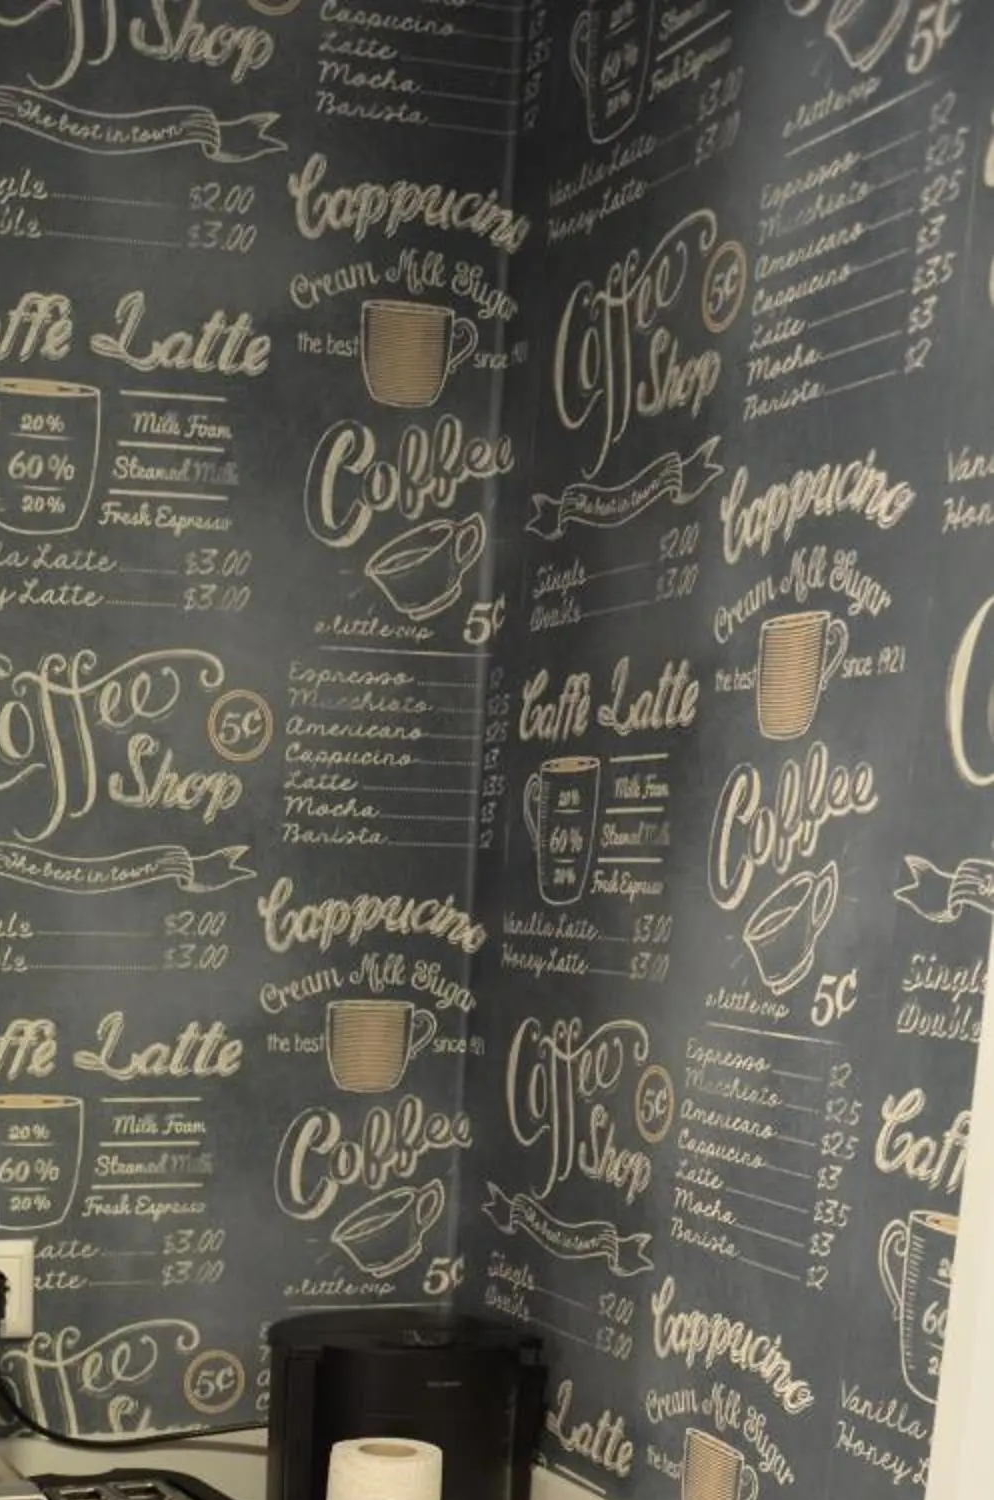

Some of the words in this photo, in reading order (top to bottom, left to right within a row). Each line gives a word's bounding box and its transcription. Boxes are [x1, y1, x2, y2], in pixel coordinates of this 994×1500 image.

[318, 60, 421, 93] Mocha
[316, 90, 428, 125] Barista
[289, 260, 382, 309] Cream
[89, 289, 273, 376] Latte
[297, 333, 323, 356] the
[326, 334, 360, 358] best
[554, 207, 717, 480] Coffee
[635, 325, 722, 419] Shop
[7, 451, 76, 482] 60%
[304, 413, 516, 549] Coffee
[20, 494, 67, 515] 20%
[98, 501, 152, 529] Fresh
[154, 504, 232, 538] Espresso
[31, 543, 118, 572] Latte
[19, 577, 105, 608] Latte
[712, 574, 778, 644] Cream
[288, 659, 416, 689] Espresso
[597, 656, 701, 737] Latte
[217, 708, 263, 746] 5¢
[285, 714, 423, 741] Americano
[107, 732, 244, 825] Shop
[283, 795, 381, 819] Mocha
[707, 740, 879, 911] Coffee
[281, 822, 390, 846] Barista
[260, 966, 344, 1015] Cream
[809, 968, 859, 1027] 5¢
[72, 1010, 245, 1083] Latte
[266, 1032, 291, 1053] the
[293, 1033, 326, 1054] best
[505, 1015, 650, 1200] Coffee
[273, 1094, 474, 1222] Coffee
[577, 1102, 653, 1206] Shop
[80, 1194, 133, 1218] Fresh
[192, 1365, 235, 1399] 5¢
[546, 1378, 634, 1478] Latte
